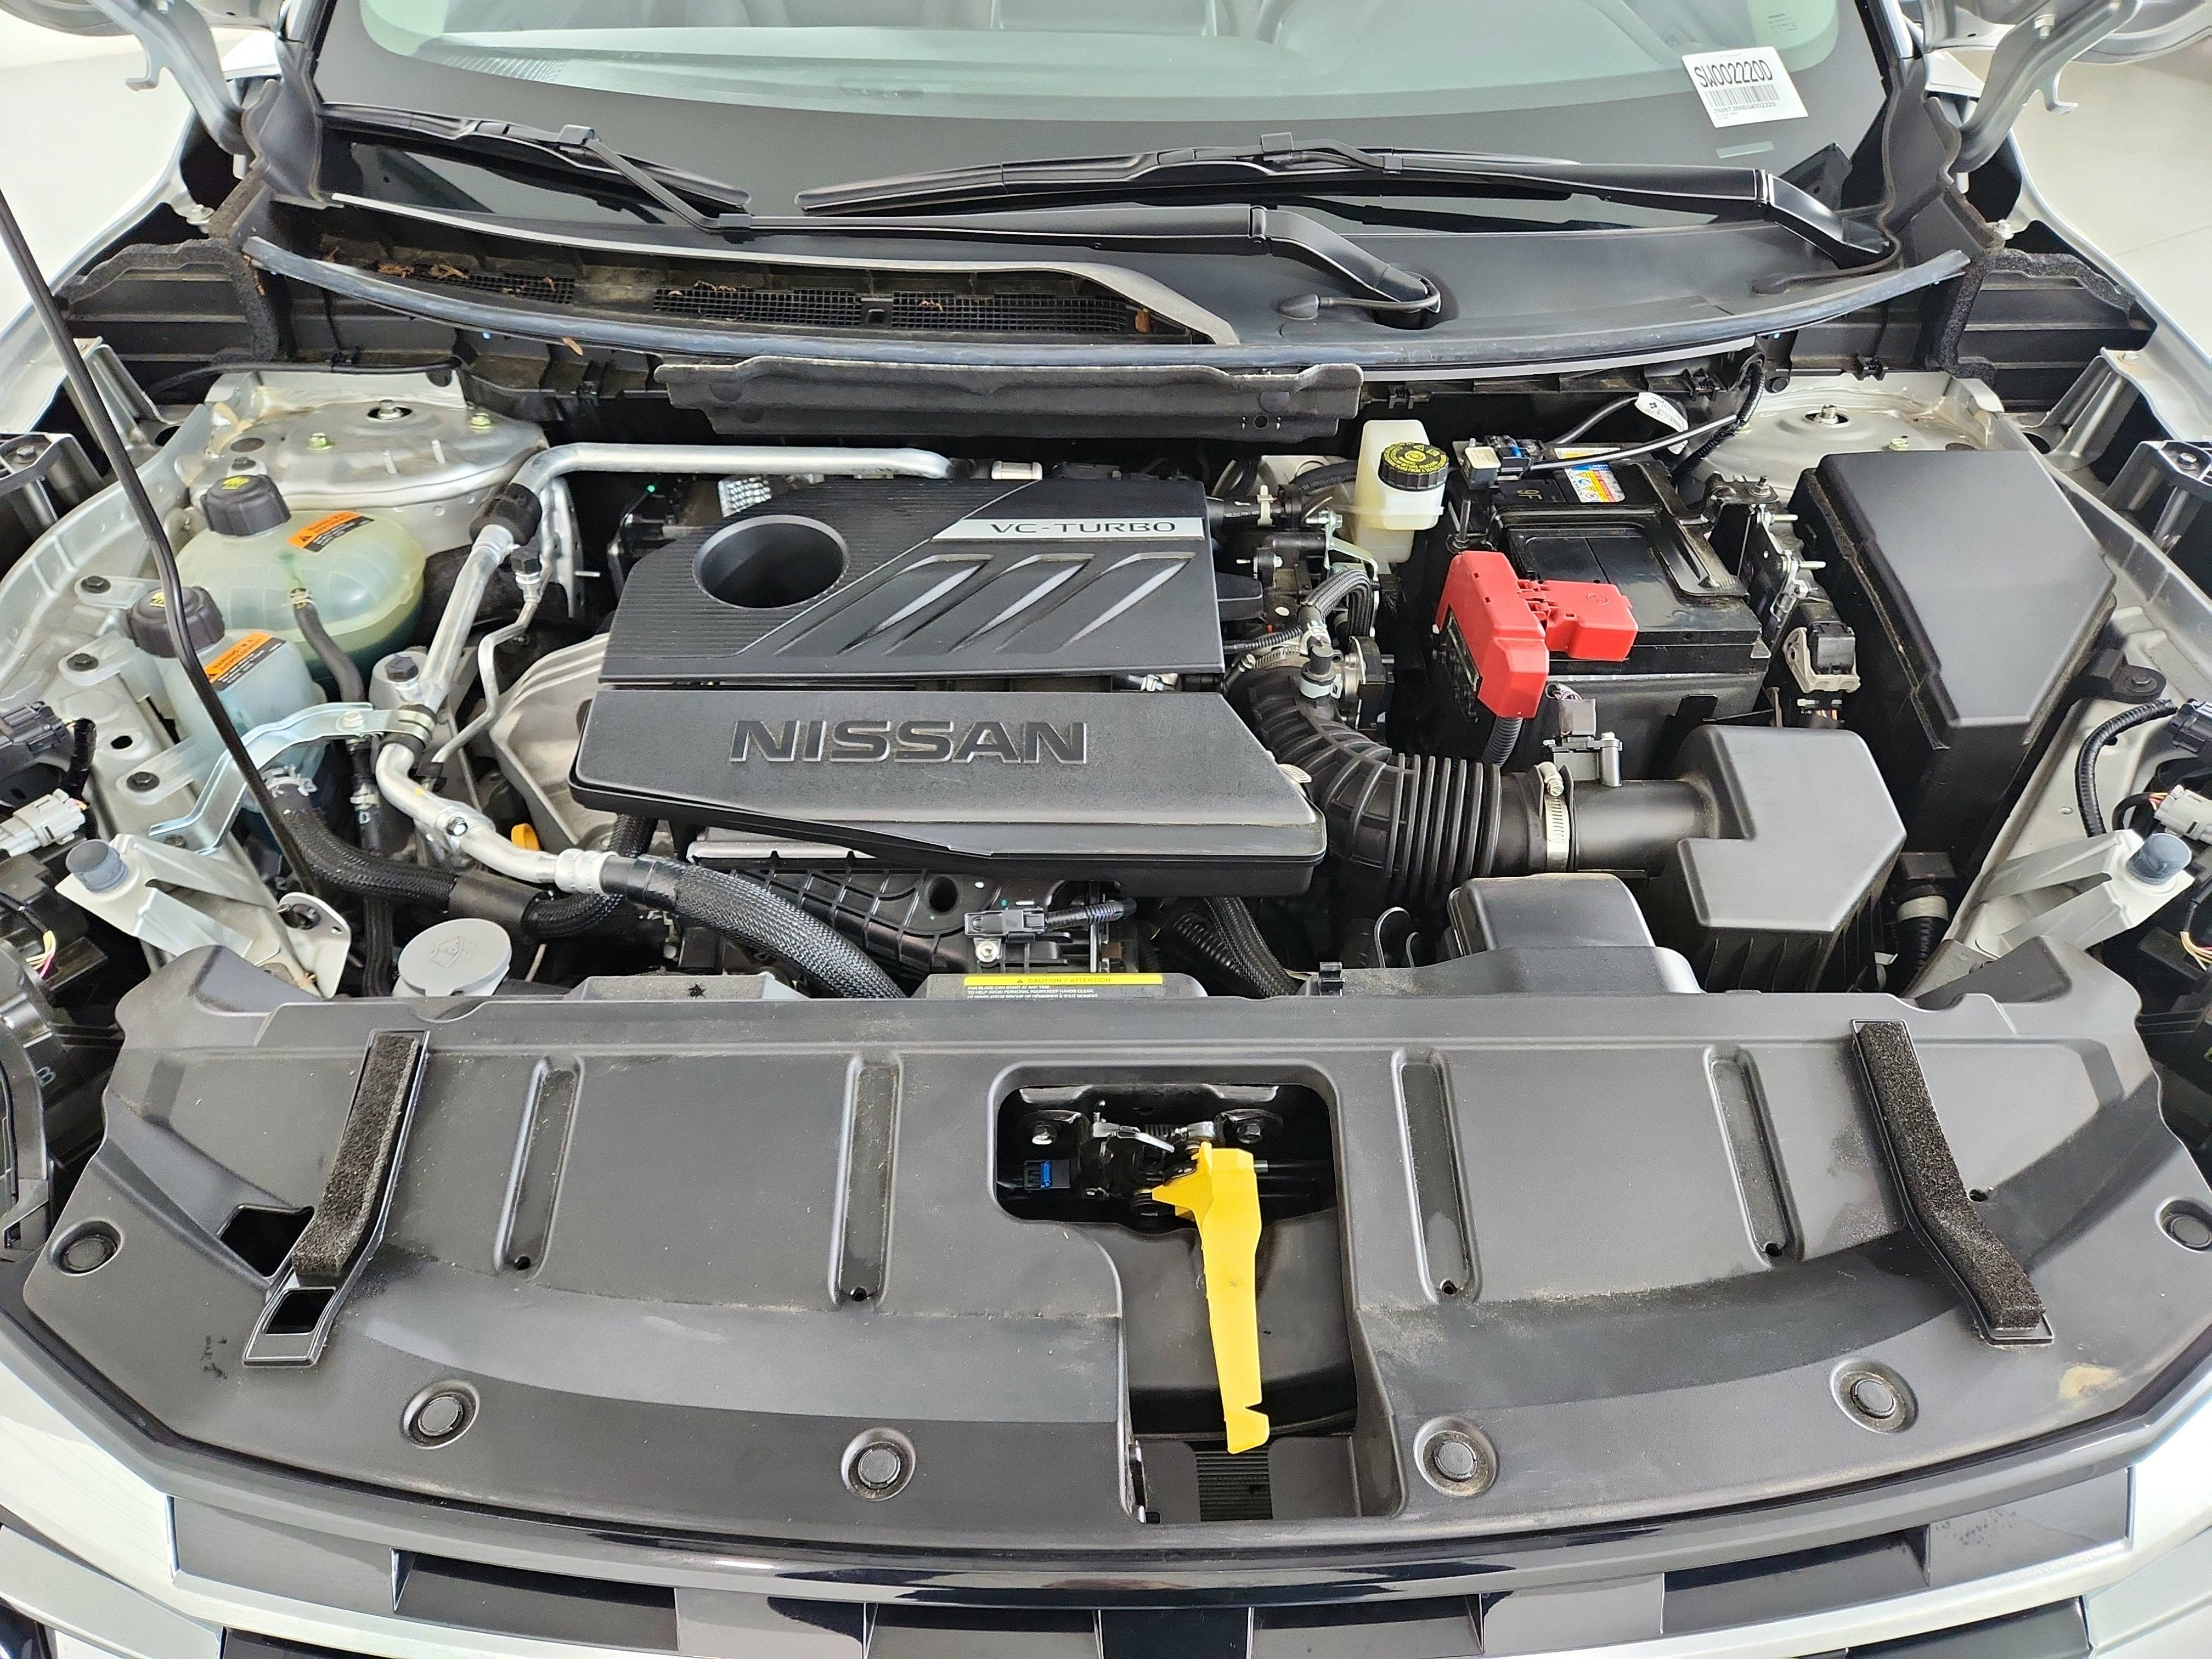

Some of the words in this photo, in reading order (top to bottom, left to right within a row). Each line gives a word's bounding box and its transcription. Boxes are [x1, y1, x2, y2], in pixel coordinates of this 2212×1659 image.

[1694, 60, 1773, 87] SW002220D
[990, 522, 1176, 533] VC-TURBO
[729, 720, 1087, 765] NISSAN
